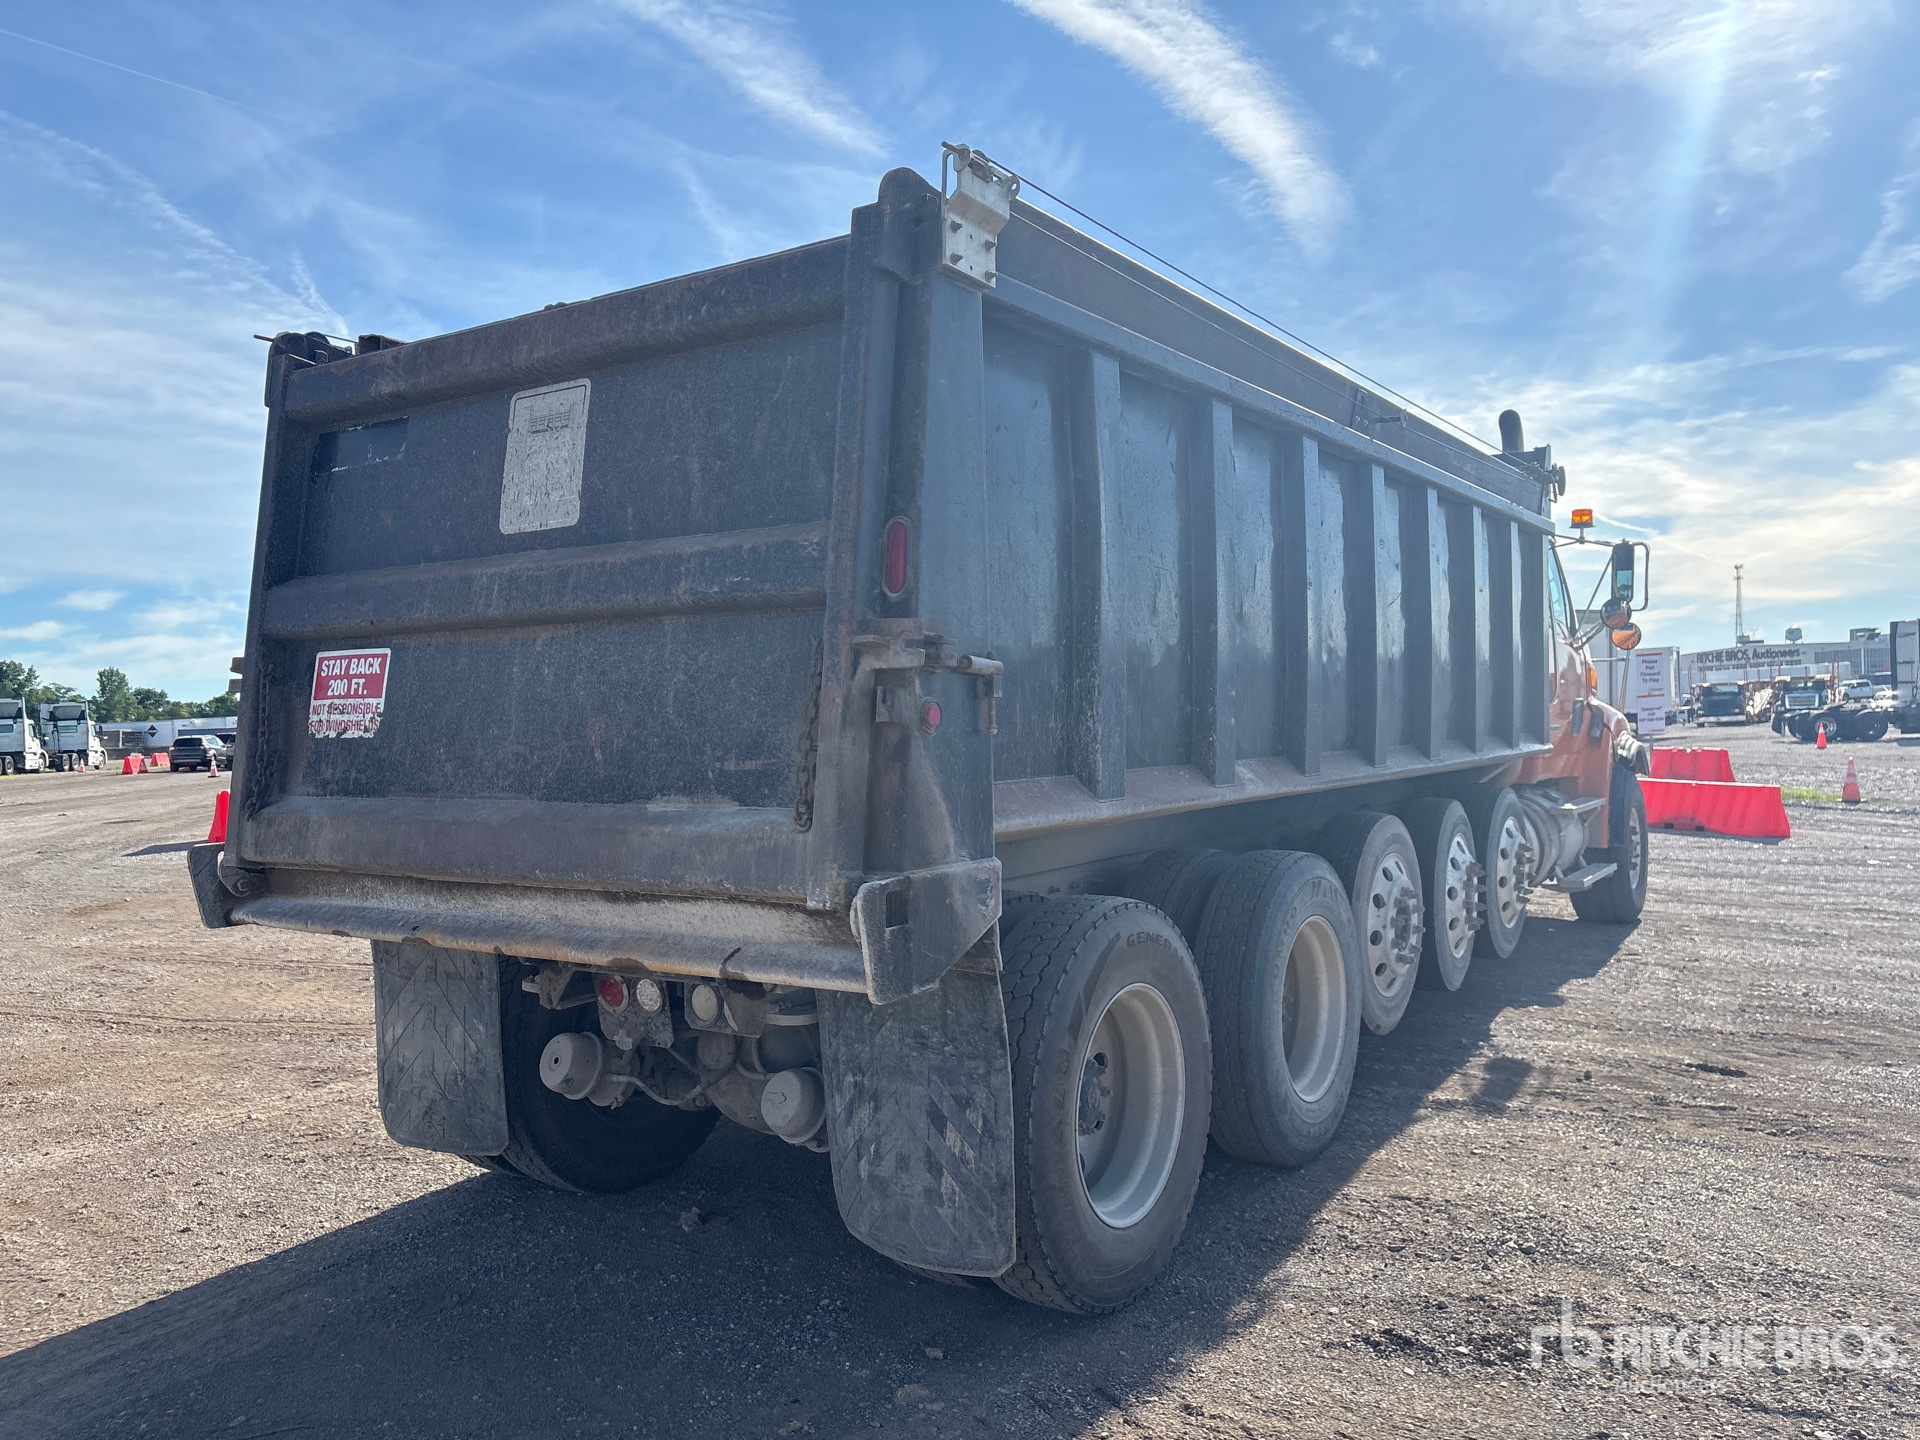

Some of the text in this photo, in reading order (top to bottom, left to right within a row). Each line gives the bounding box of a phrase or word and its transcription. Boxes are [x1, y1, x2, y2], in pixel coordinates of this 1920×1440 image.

[1696, 650, 1724, 664] RITCHIE
[1752, 647, 1800, 660] Auctioneers
[321, 657, 382, 677] STAY BACK
[327, 678, 367, 696] 200 FT.
[311, 703, 327, 716] NOT
